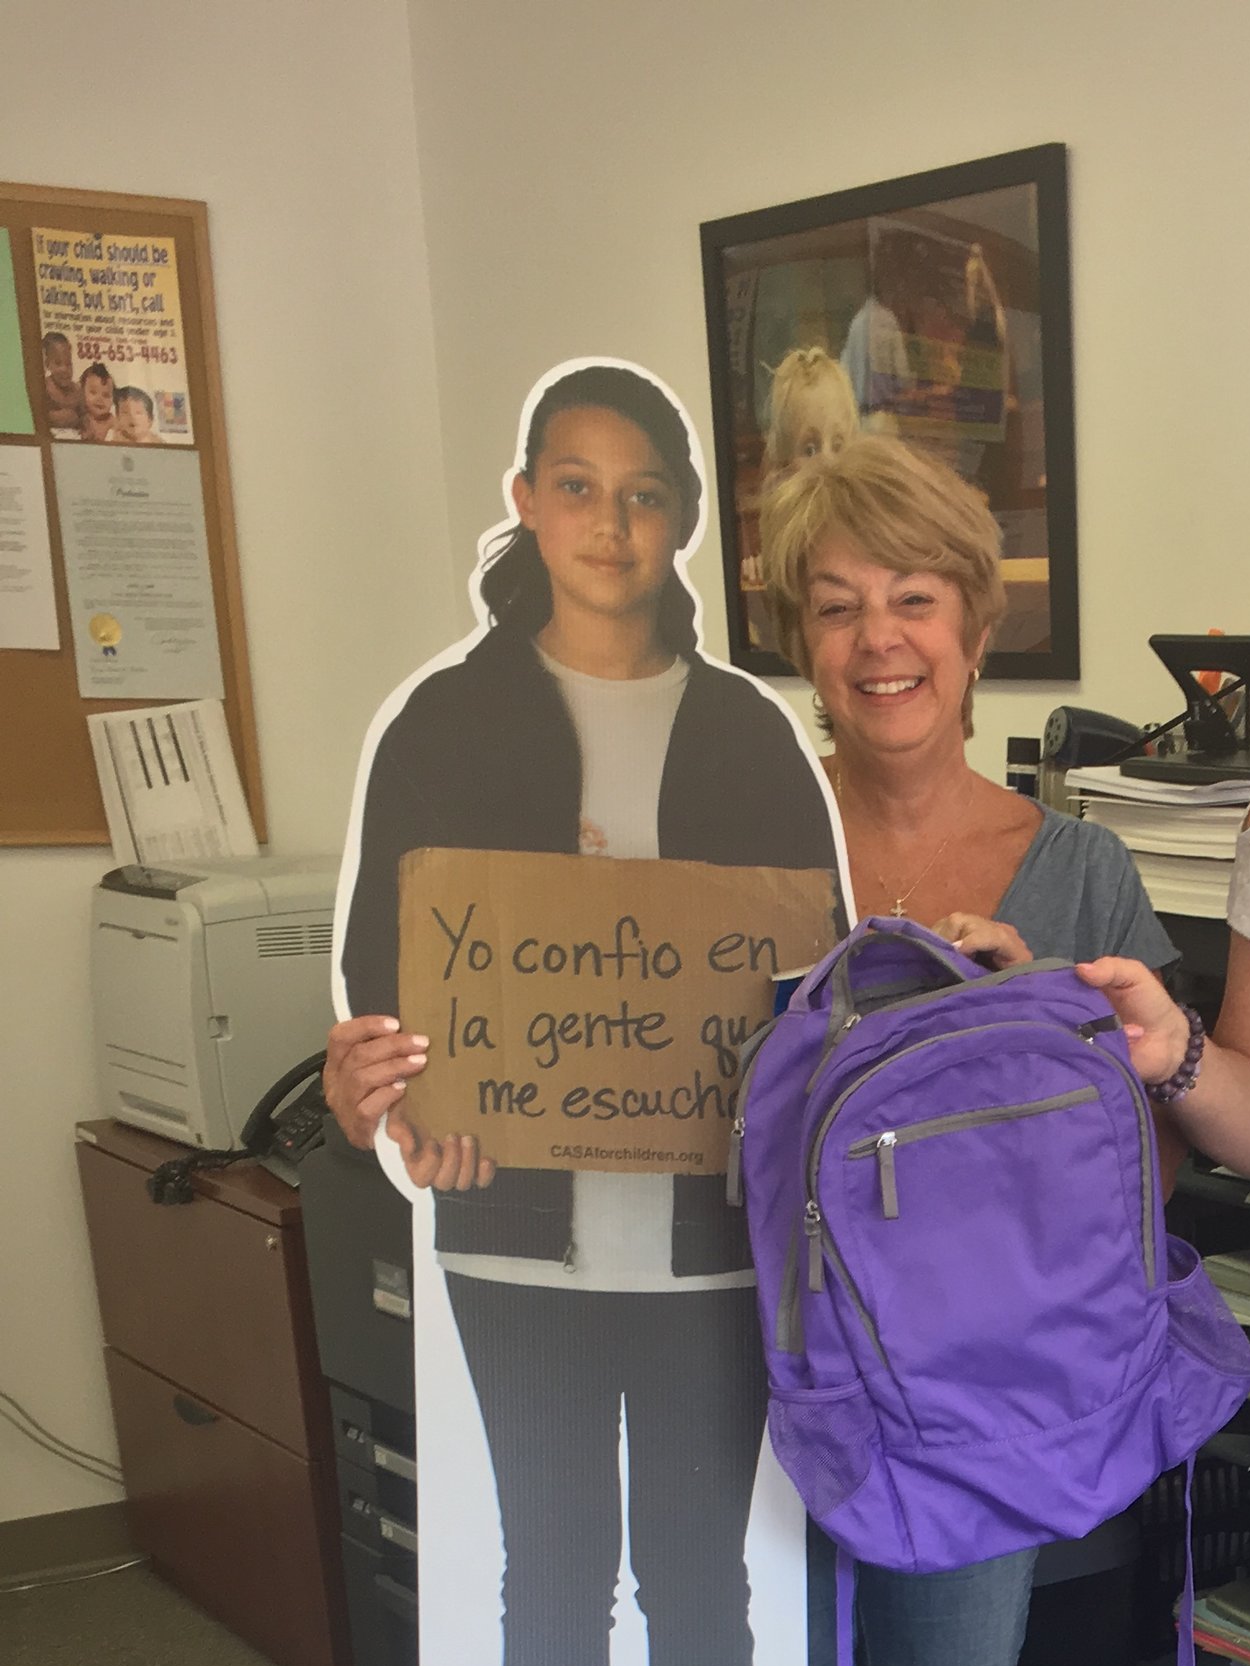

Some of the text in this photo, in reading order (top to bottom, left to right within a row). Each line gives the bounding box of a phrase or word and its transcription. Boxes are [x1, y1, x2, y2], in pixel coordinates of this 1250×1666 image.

[36, 234, 168, 264] If your child should be
[39, 261, 156, 291] crawling, walking or
[41, 285, 80, 312] talking,
[83, 290, 104, 309] but
[141, 293, 164, 312] call
[77, 341, 178, 364] 888-653-4463
[431, 903, 493, 981] Yo
[707, 932, 779, 974] en
[447, 997, 496, 1058] la
[527, 1001, 674, 1069] gente
[478, 1078, 546, 1115] me
[550, 1145, 704, 1165] CASAforchildren.org
